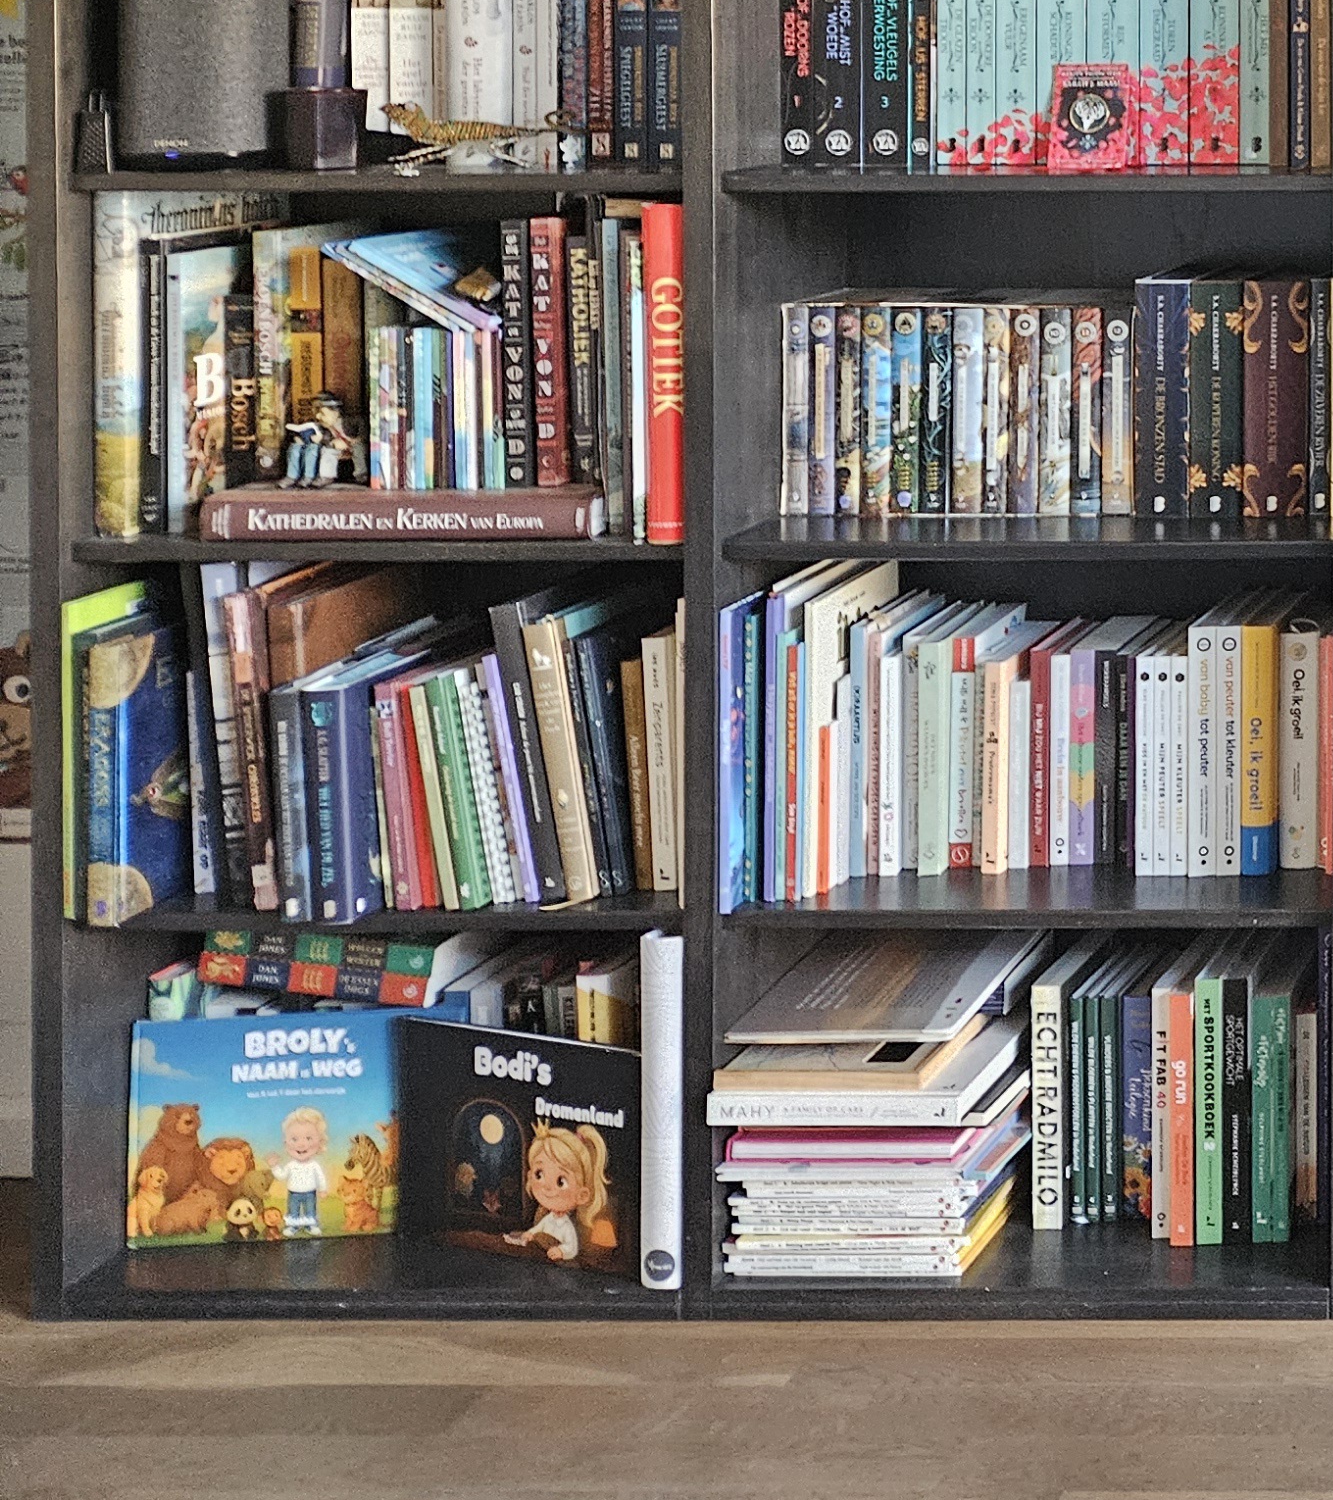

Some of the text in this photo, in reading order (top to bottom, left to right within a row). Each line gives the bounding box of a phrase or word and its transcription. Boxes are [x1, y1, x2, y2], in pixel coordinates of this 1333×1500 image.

[826, 10, 838, 60] WOEDE
[839, 0, 851, 65] HOF MIST
[885, 17, 898, 81] VLEUGELS
[571, 246, 591, 366] KATHOLIEK
[651, 275, 684, 417] GOTIEK
[1154, 376, 1166, 392] DE
[1154, 394, 1166, 449] BRONZEN
[1154, 452, 1166, 483] STAD
[247, 508, 373, 531] KATHEDRALEN
[396, 507, 468, 531] KERKEN
[1224, 655, 1235, 678] van
[1222, 678, 1236, 717] peuter
[1224, 719, 1236, 735] tot
[1223, 738, 1236, 778] kleuter
[1246, 716, 1264, 810] Oei, ik groei!
[259, 942, 288, 952] JONES
[252, 972, 280, 984] JONES
[474, 1046, 554, 1086] Bodi's
[1172, 1060, 1186, 1104] go run
[535, 1097, 625, 1129] Dromenland
[1036, 1012, 1060, 1207] ECHT RADMILO
